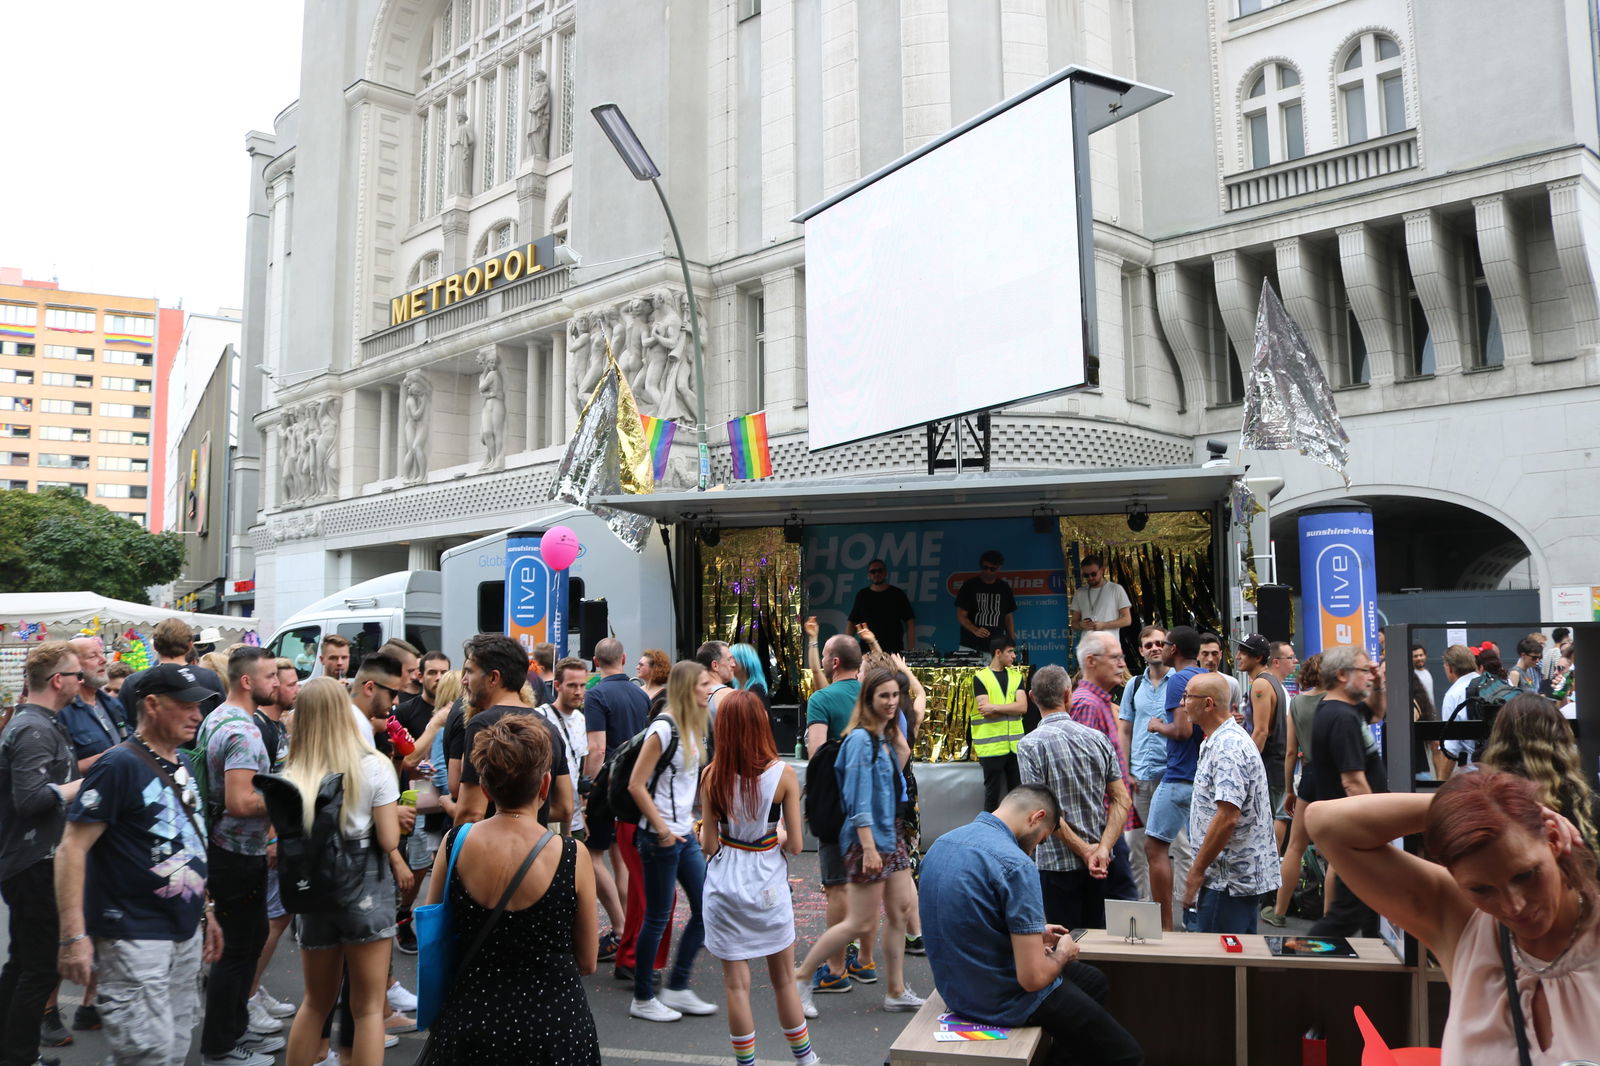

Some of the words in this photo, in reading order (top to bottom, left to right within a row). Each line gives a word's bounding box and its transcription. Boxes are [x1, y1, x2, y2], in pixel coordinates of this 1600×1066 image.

[391, 243, 546, 326] METROPOL
[806, 530, 945, 570] HOME
[516, 567, 536, 618] live
[804, 573, 856, 606] OF
[886, 571, 941, 602] HE
[952, 575, 1044, 589] shine
[1330, 555, 1351, 608] live
[1015, 599, 1033, 607] usic
[1368, 601, 1376, 639] radio
